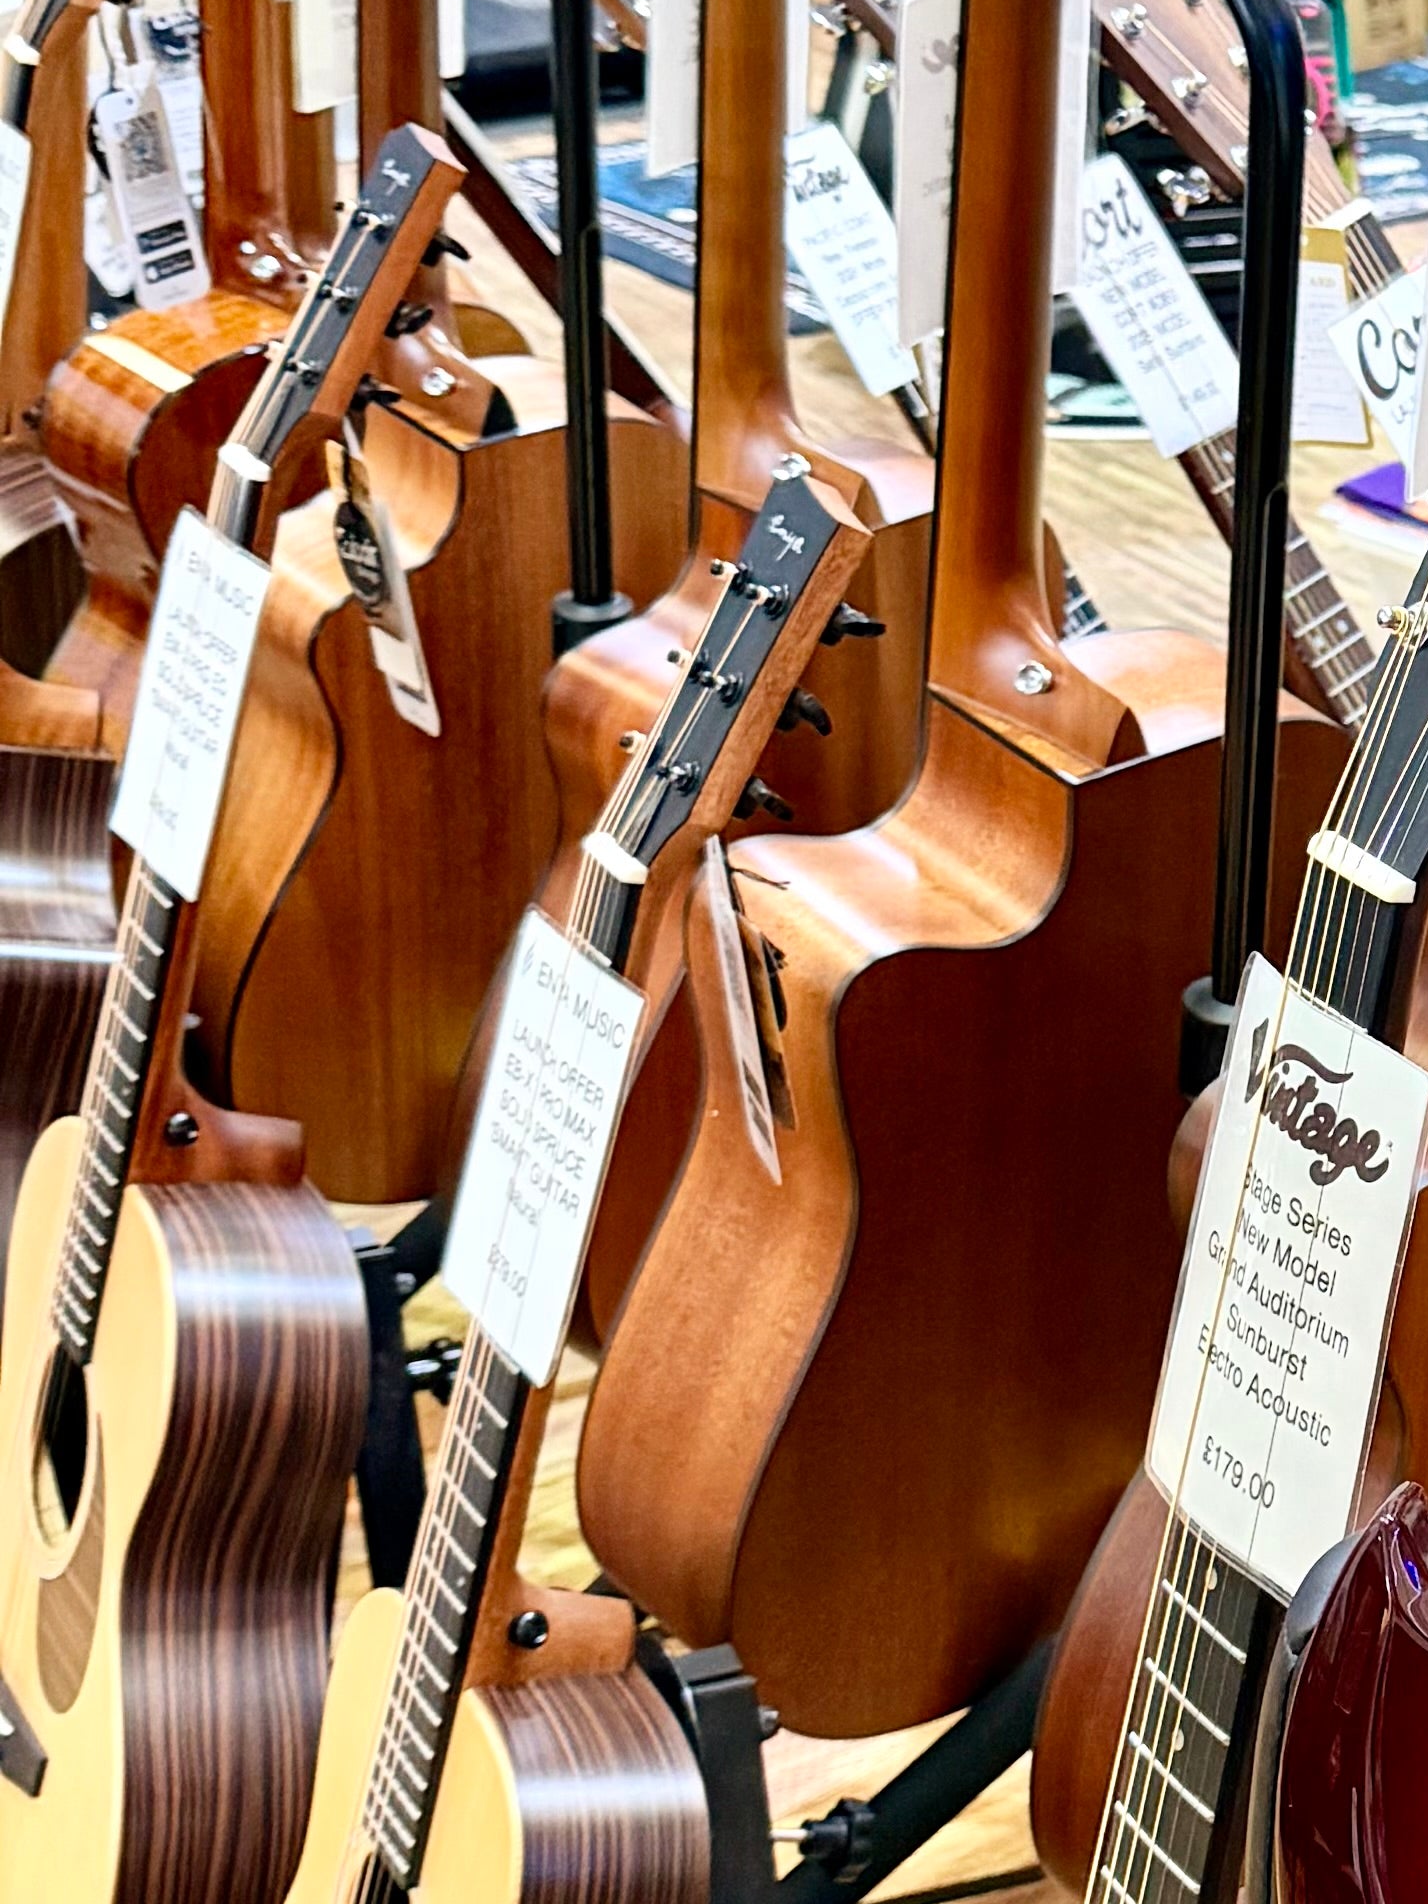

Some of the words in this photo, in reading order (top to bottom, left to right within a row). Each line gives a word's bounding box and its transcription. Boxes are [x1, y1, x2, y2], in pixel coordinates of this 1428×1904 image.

[536, 960, 570, 1008] ENA
[572, 992, 627, 1051] MUSIC
[558, 1059, 605, 1112] OFFER
[1244, 1017, 1390, 1187] Vintage
[529, 1161, 582, 1219] GUITAR
[532, 1120, 587, 1181] SPRUCE
[1237, 1207, 1271, 1257] New
[1271, 1236, 1338, 1298] Model
[1243, 1164, 1282, 1216] Stage
[1286, 1196, 1353, 1258] Series
[1226, 1302, 1308, 1383] Sunburst
[1246, 1270, 1350, 1360] Auditorium
[1197, 1322, 1244, 1390] Eectro
[1245, 1372, 1333, 1449] Acoustic
[1201, 1434, 1276, 1511] £179.00
